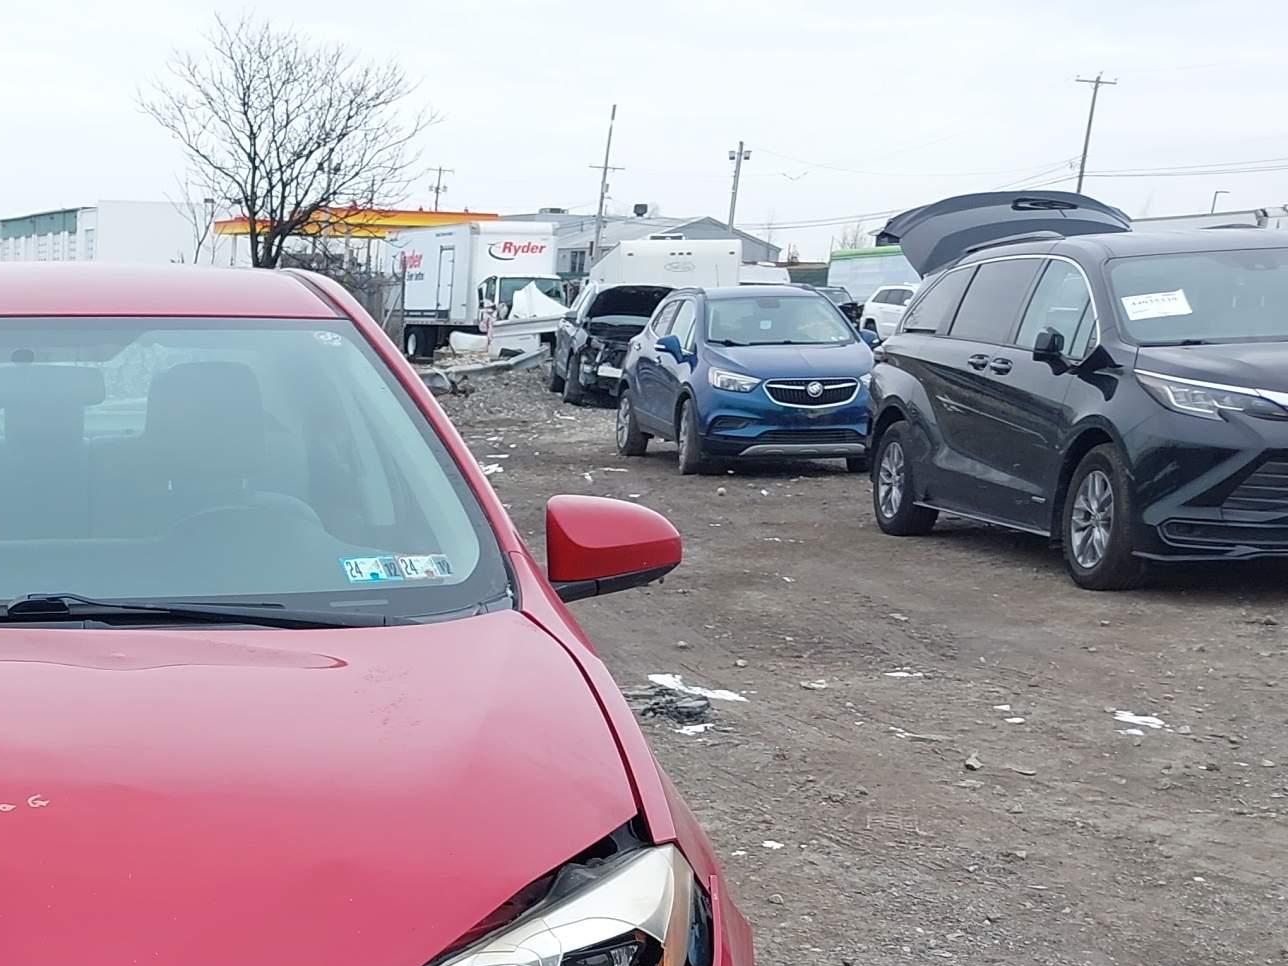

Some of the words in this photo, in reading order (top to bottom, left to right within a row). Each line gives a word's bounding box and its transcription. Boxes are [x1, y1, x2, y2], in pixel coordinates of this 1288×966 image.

[502, 241, 546, 256] Ryder
[345, 561, 363, 578] 24
[401, 558, 418, 576] 24
